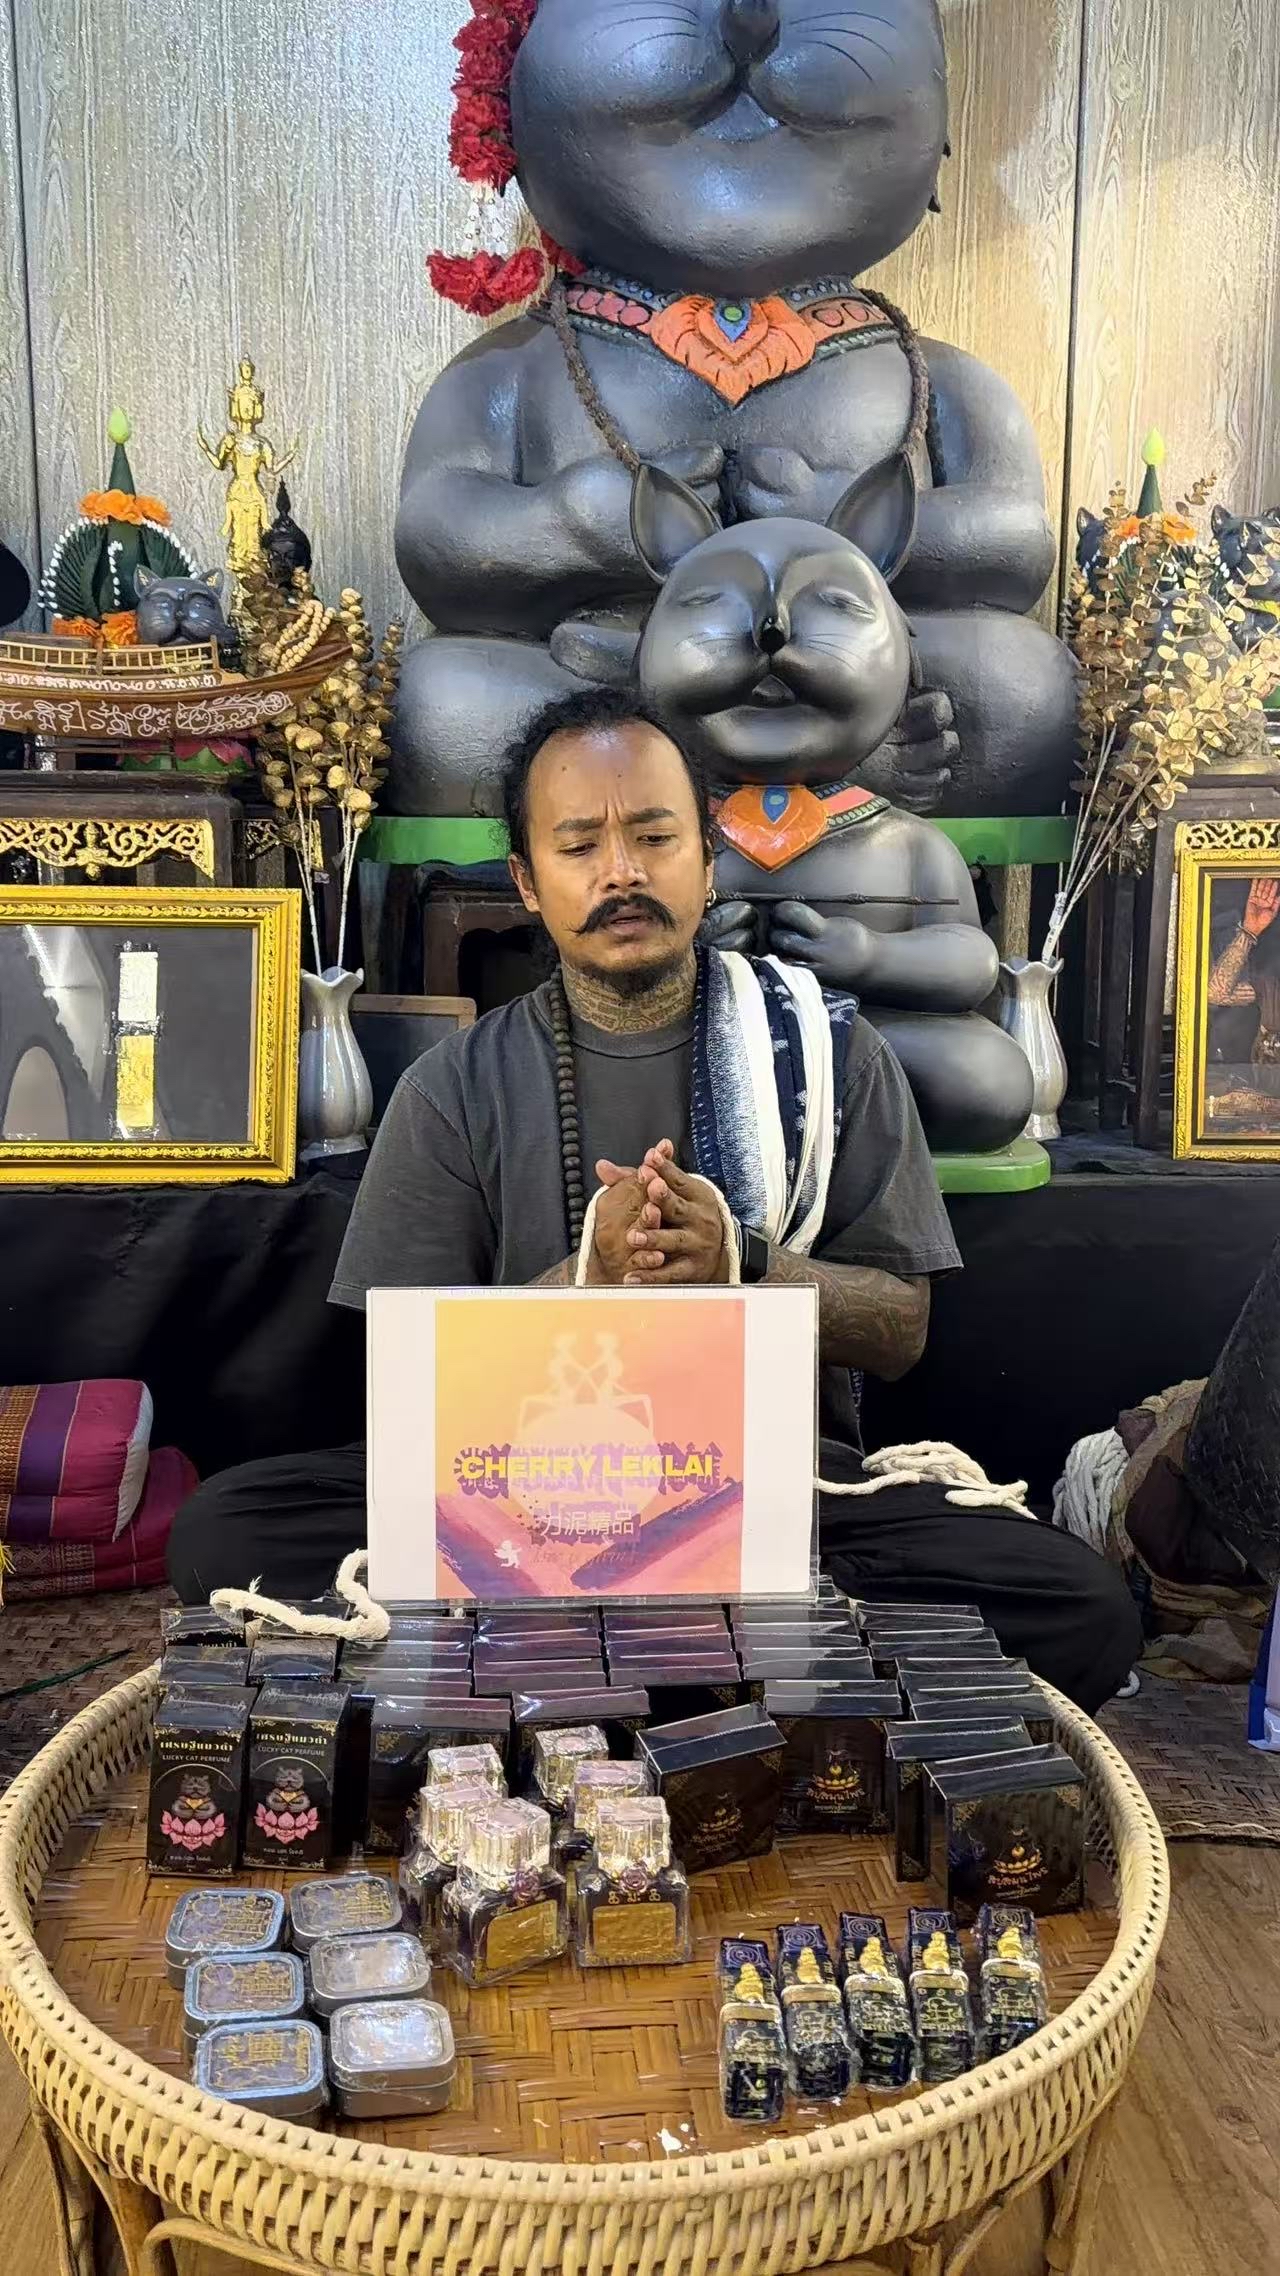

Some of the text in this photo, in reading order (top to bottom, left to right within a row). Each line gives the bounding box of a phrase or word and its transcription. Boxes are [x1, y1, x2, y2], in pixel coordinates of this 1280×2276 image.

[461, 1455, 597, 1480] CHERRY
[535, 1507, 634, 1537] 力泥精品
[200, 1755, 231, 1763] PERFUME
[257, 1745, 278, 1753] LUCKY
[294, 1748, 325, 1757] PERFUME
